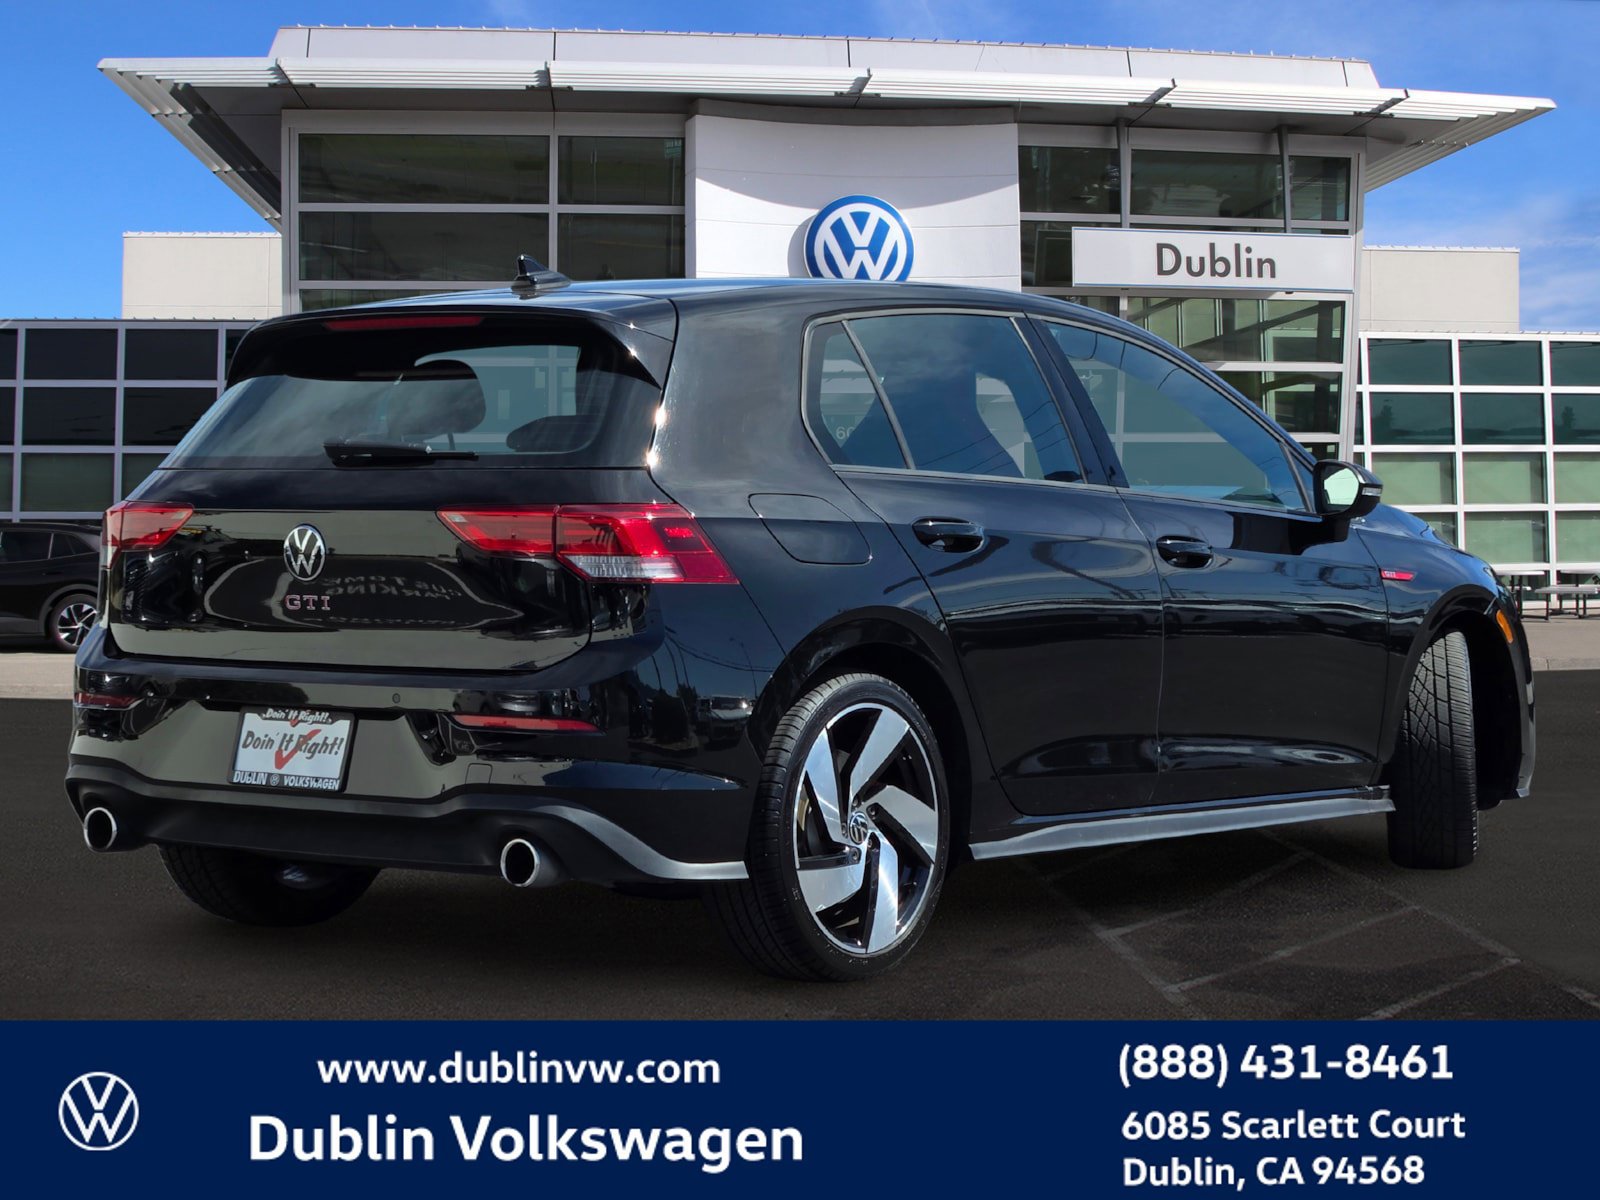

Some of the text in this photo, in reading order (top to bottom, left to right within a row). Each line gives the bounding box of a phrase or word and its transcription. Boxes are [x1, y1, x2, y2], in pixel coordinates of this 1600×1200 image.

[1156, 242, 1276, 279] Dublin
[284, 594, 331, 611] GTI
[280, 733, 293, 752] It
[296, 734, 345, 760] Right!
[233, 771, 340, 791] DUBLIN VOLKSWAGEN
